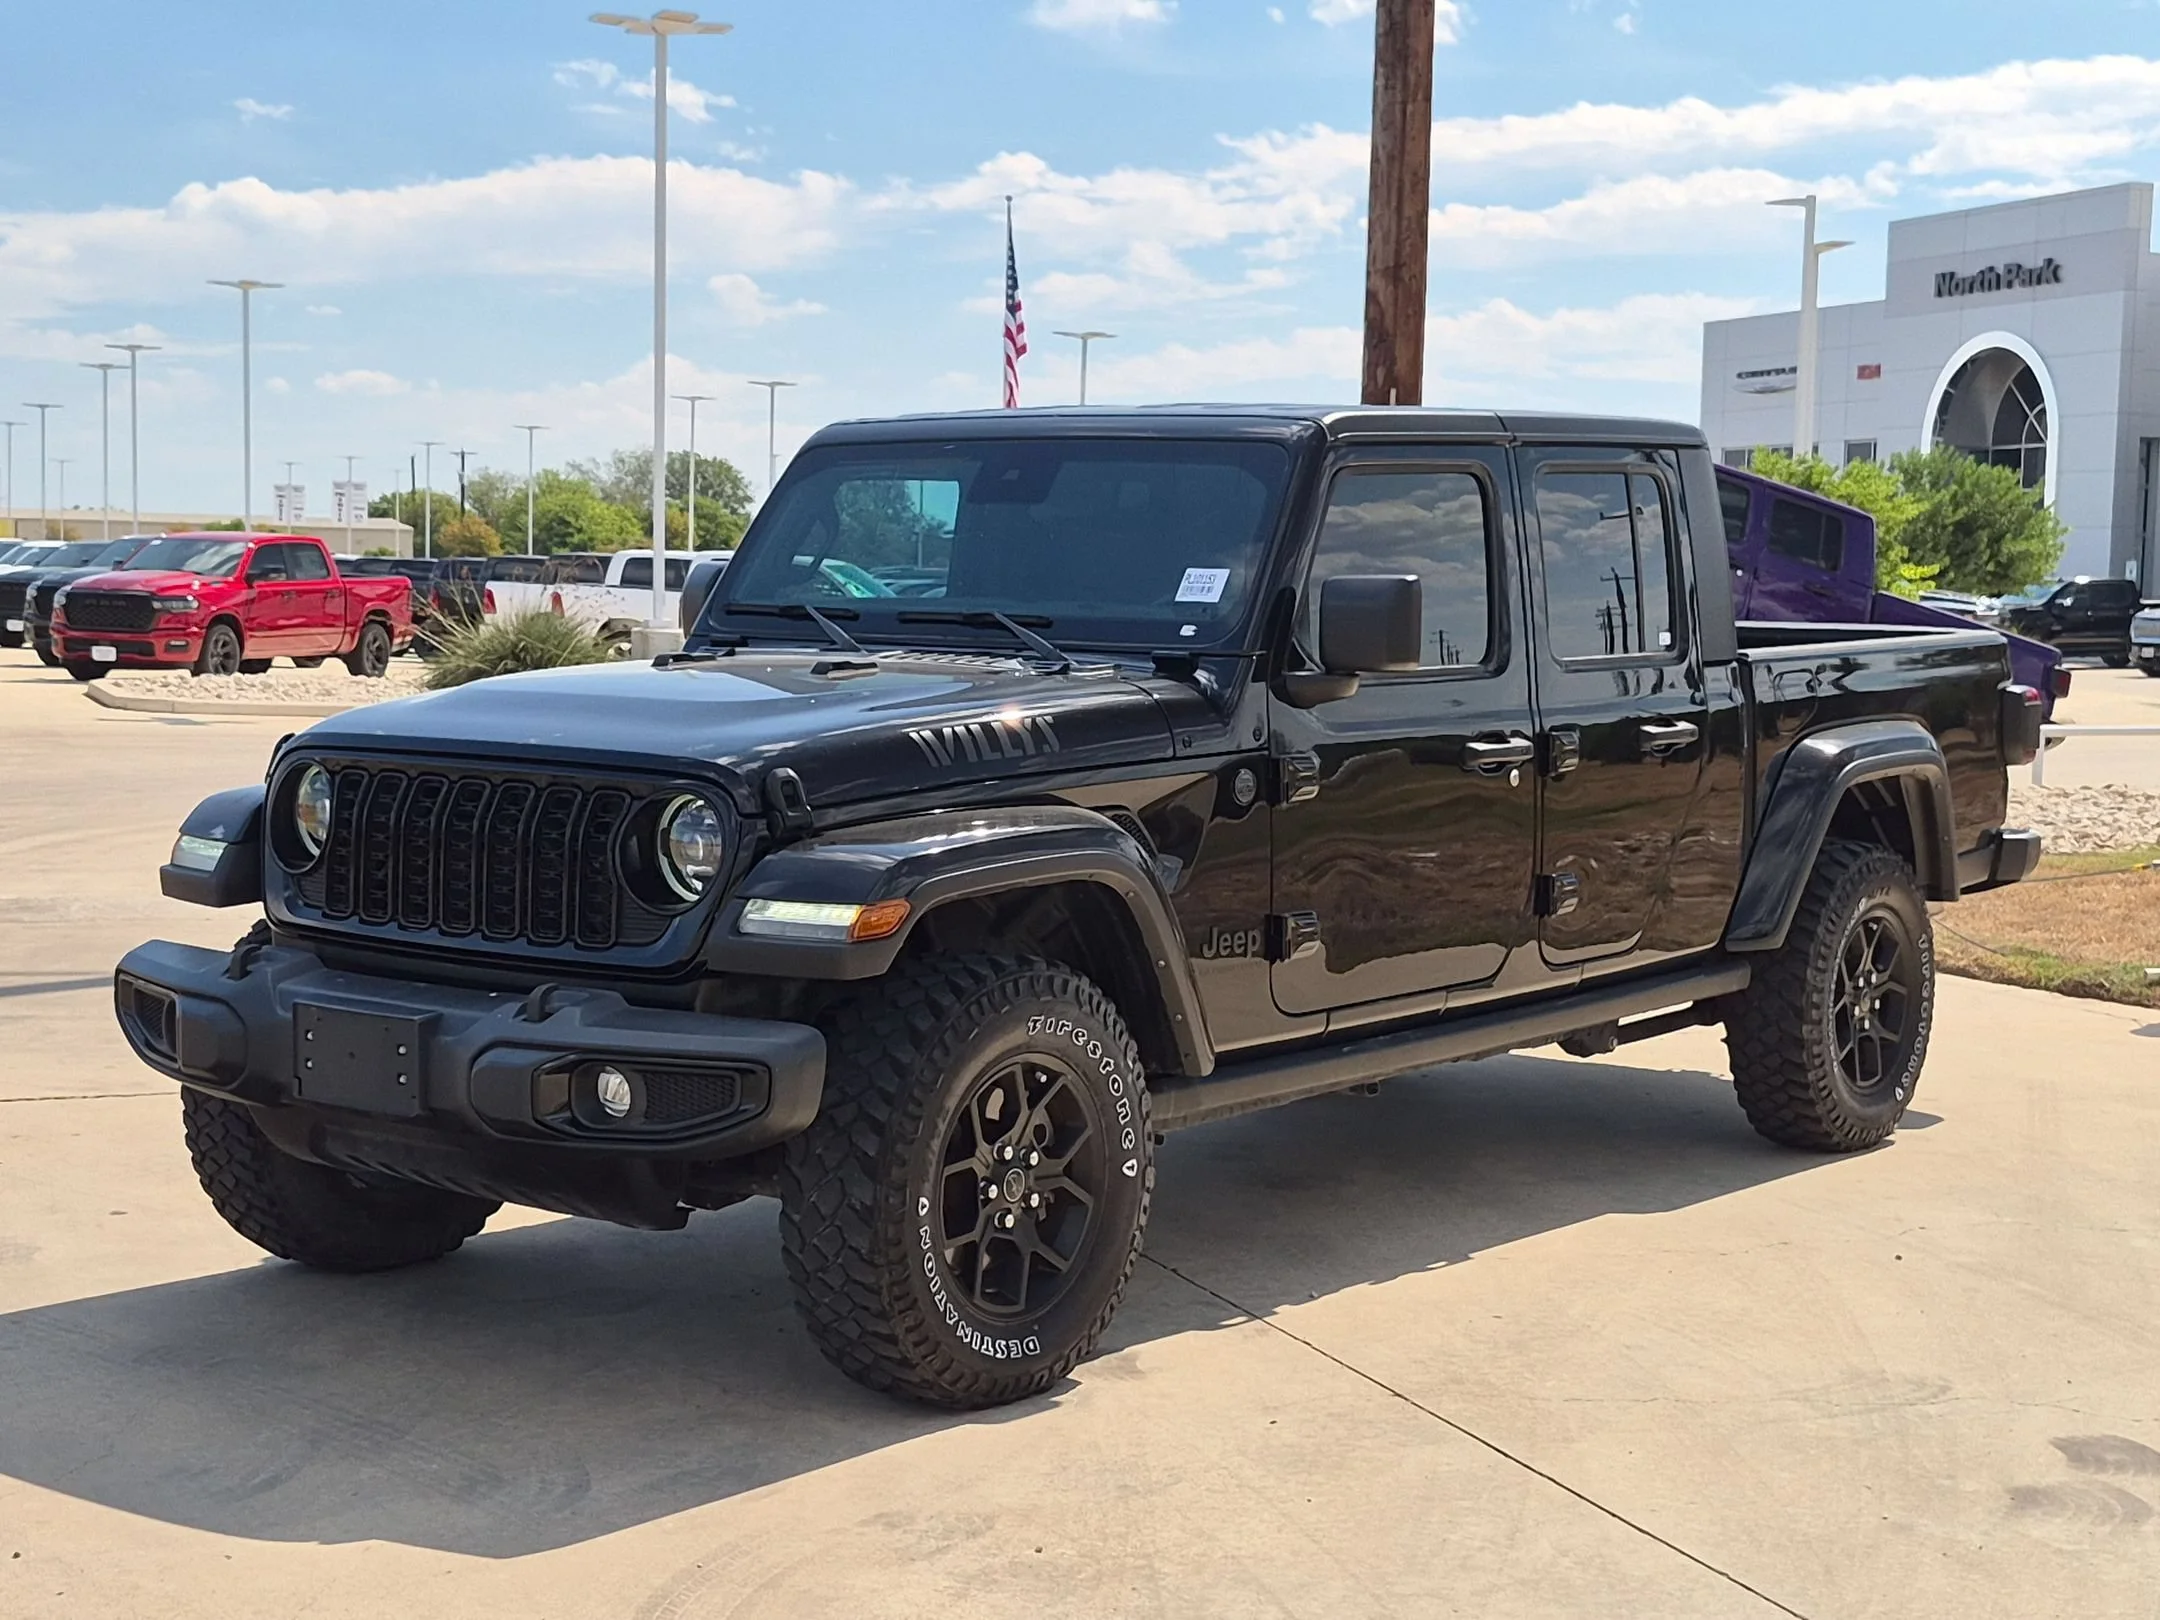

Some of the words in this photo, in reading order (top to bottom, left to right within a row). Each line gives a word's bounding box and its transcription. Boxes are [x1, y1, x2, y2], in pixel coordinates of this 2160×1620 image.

[1934, 266, 2001, 298] North
[2001, 257, 2062, 290] Park
[909, 715, 1060, 768] WILLYS
[1202, 926, 1261, 959] Jeep
[1026, 1015, 1137, 1151] Firestone
[918, 1225, 1041, 1360] DESTINATION
